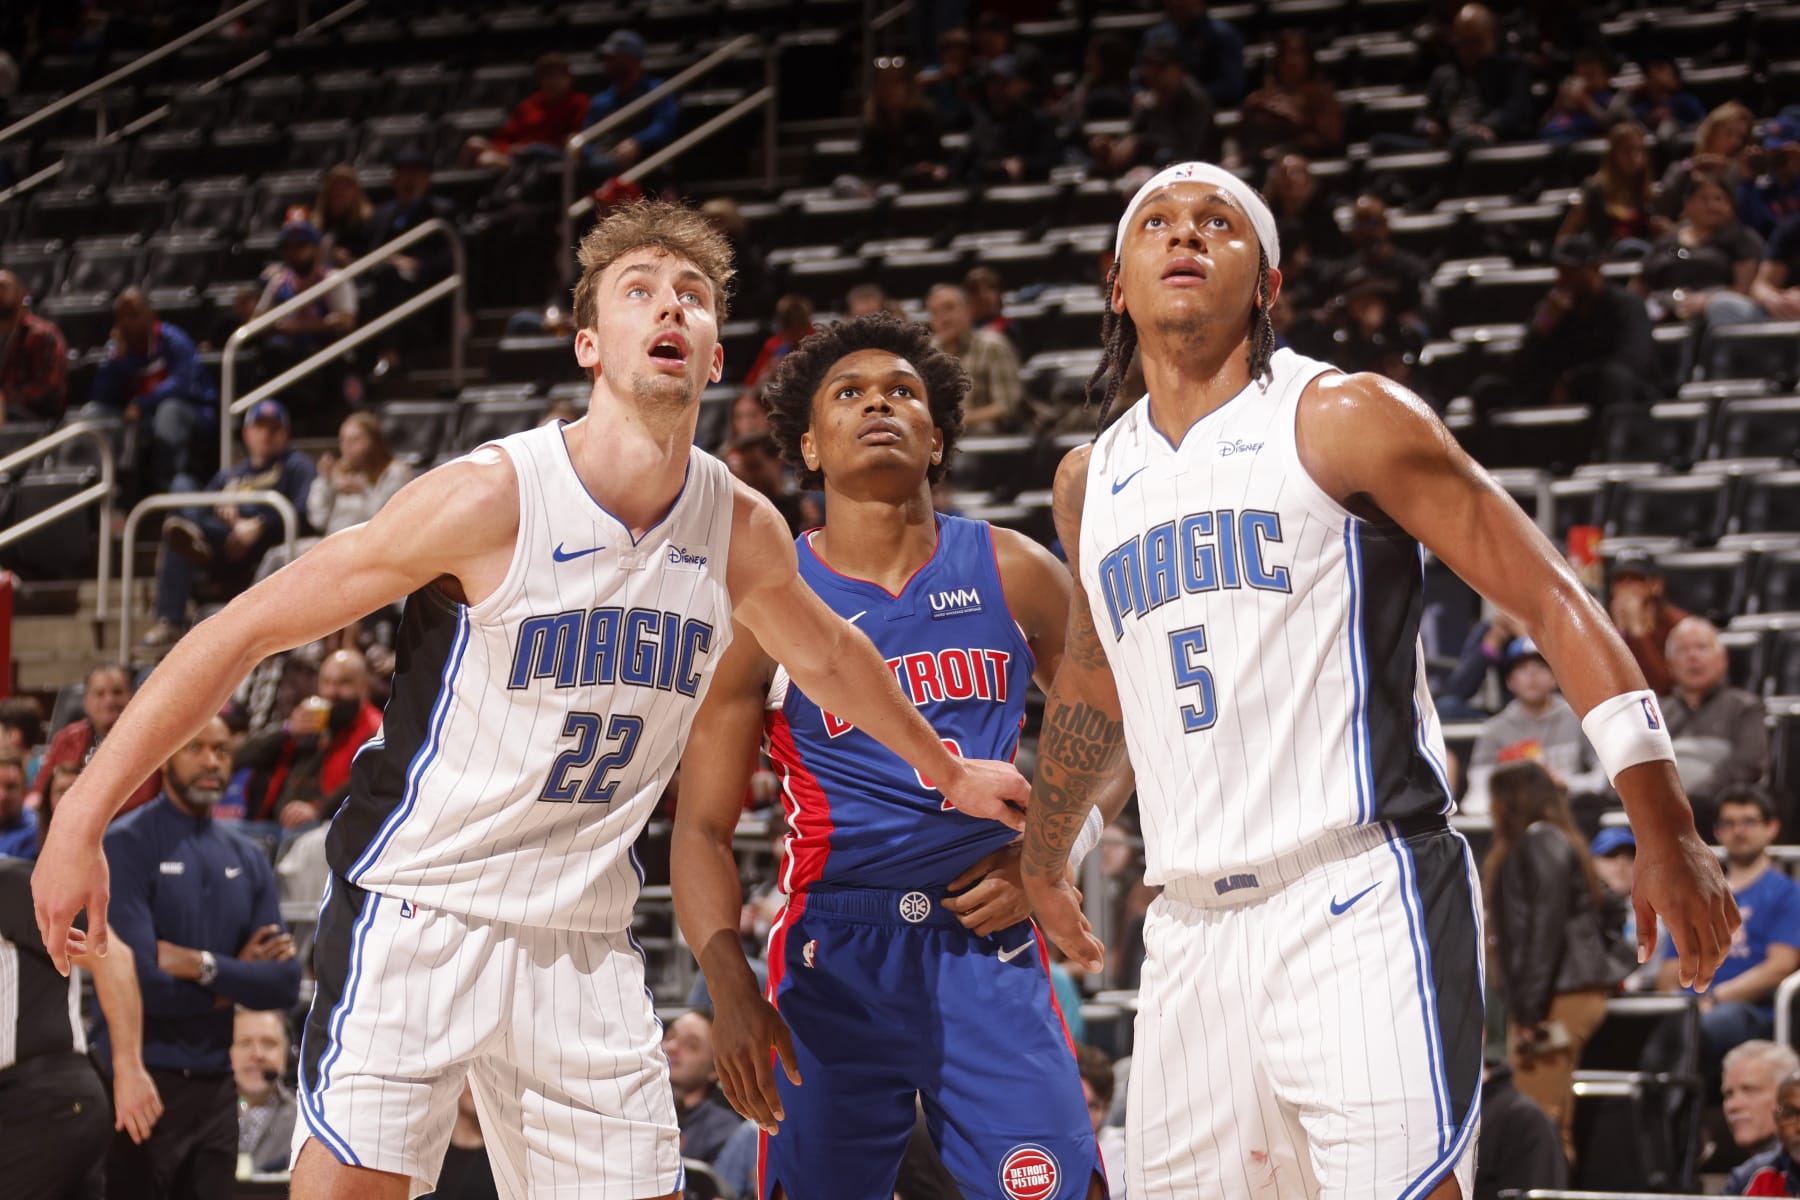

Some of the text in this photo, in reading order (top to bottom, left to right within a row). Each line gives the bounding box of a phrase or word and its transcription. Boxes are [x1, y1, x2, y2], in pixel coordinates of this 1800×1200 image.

[929, 588, 981, 611] UWM
[1098, 508, 1293, 643] MAGIC
[507, 606, 714, 699] MAGIC
[1167, 624, 1218, 735] 5
[537, 711, 644, 804] 22
[1009, 1163, 1048, 1179] DETROIT
[1011, 1173, 1050, 1190] PISTONS
